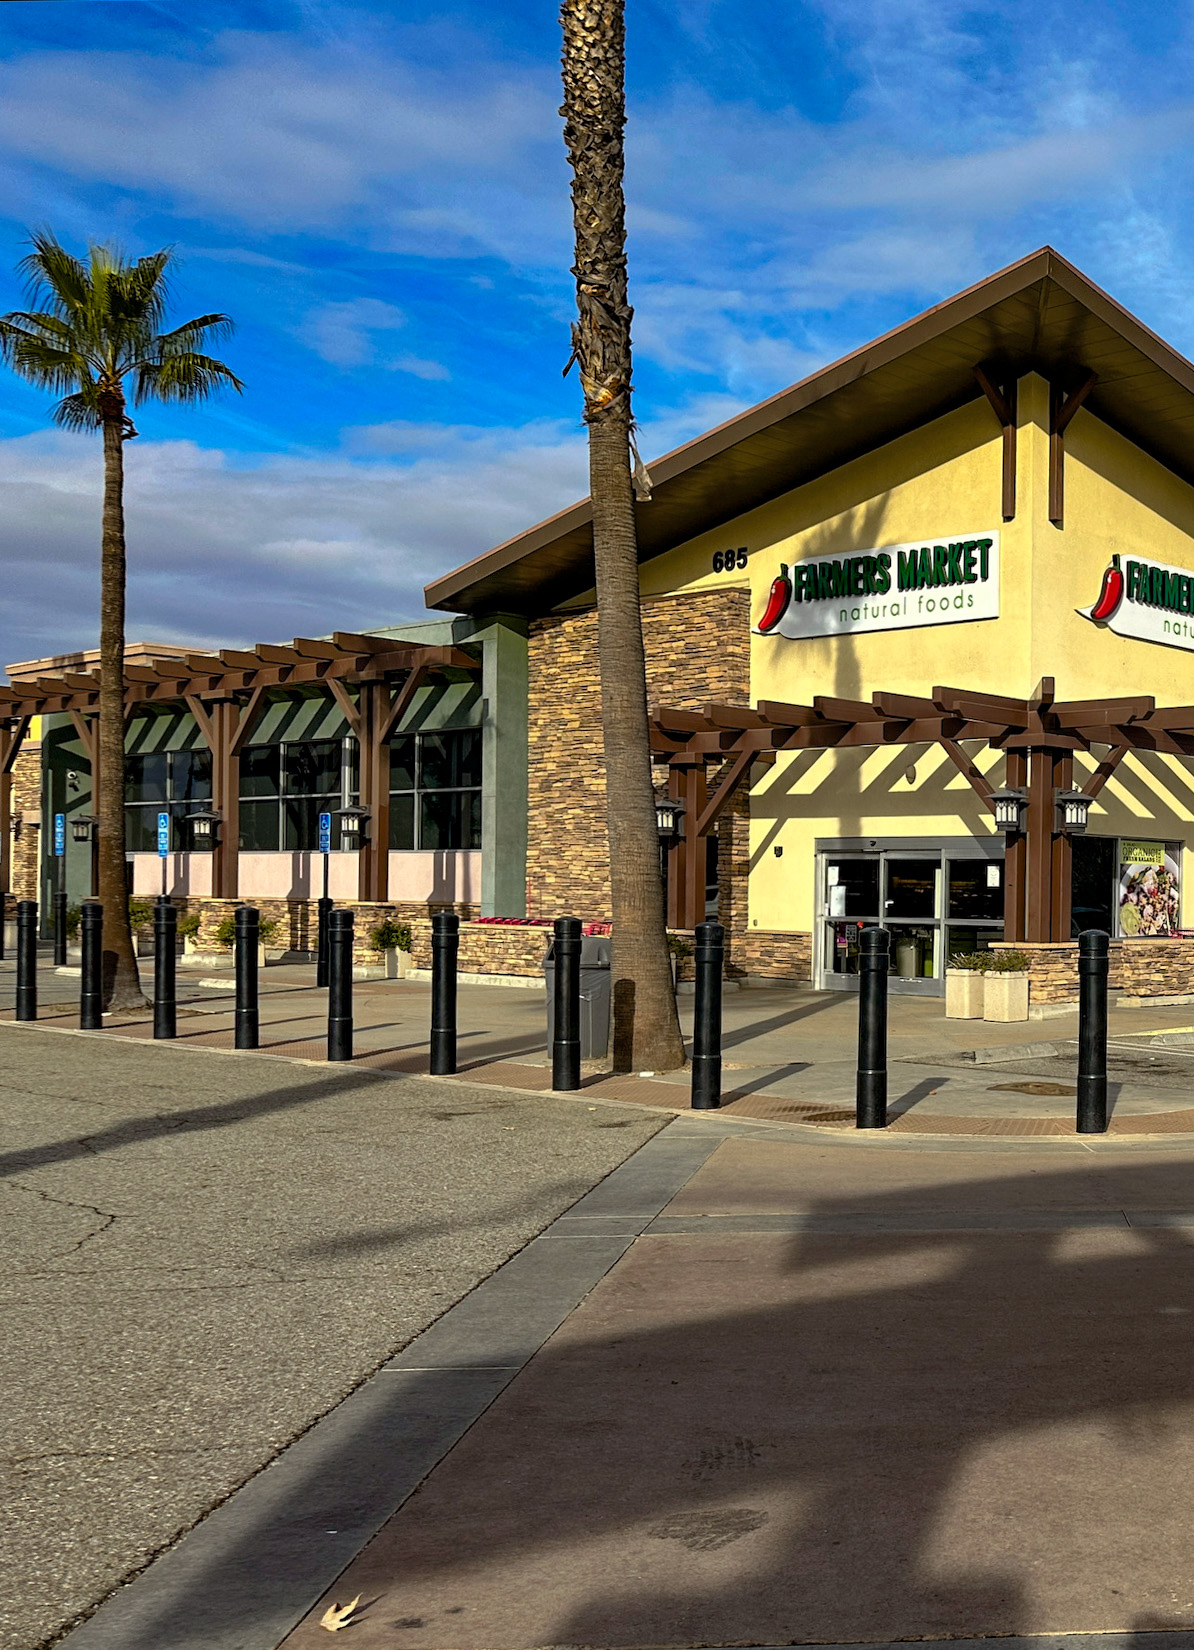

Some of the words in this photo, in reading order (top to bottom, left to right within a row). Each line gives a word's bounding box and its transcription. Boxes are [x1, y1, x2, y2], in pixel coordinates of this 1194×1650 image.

[713, 547, 748, 573] 685
[795, 554, 891, 602] FARMERS
[898, 538, 993, 591] MARKET
[839, 597, 906, 622] natural
[918, 589, 974, 613] foods
[1122, 847, 1156, 857] ORGANIC
